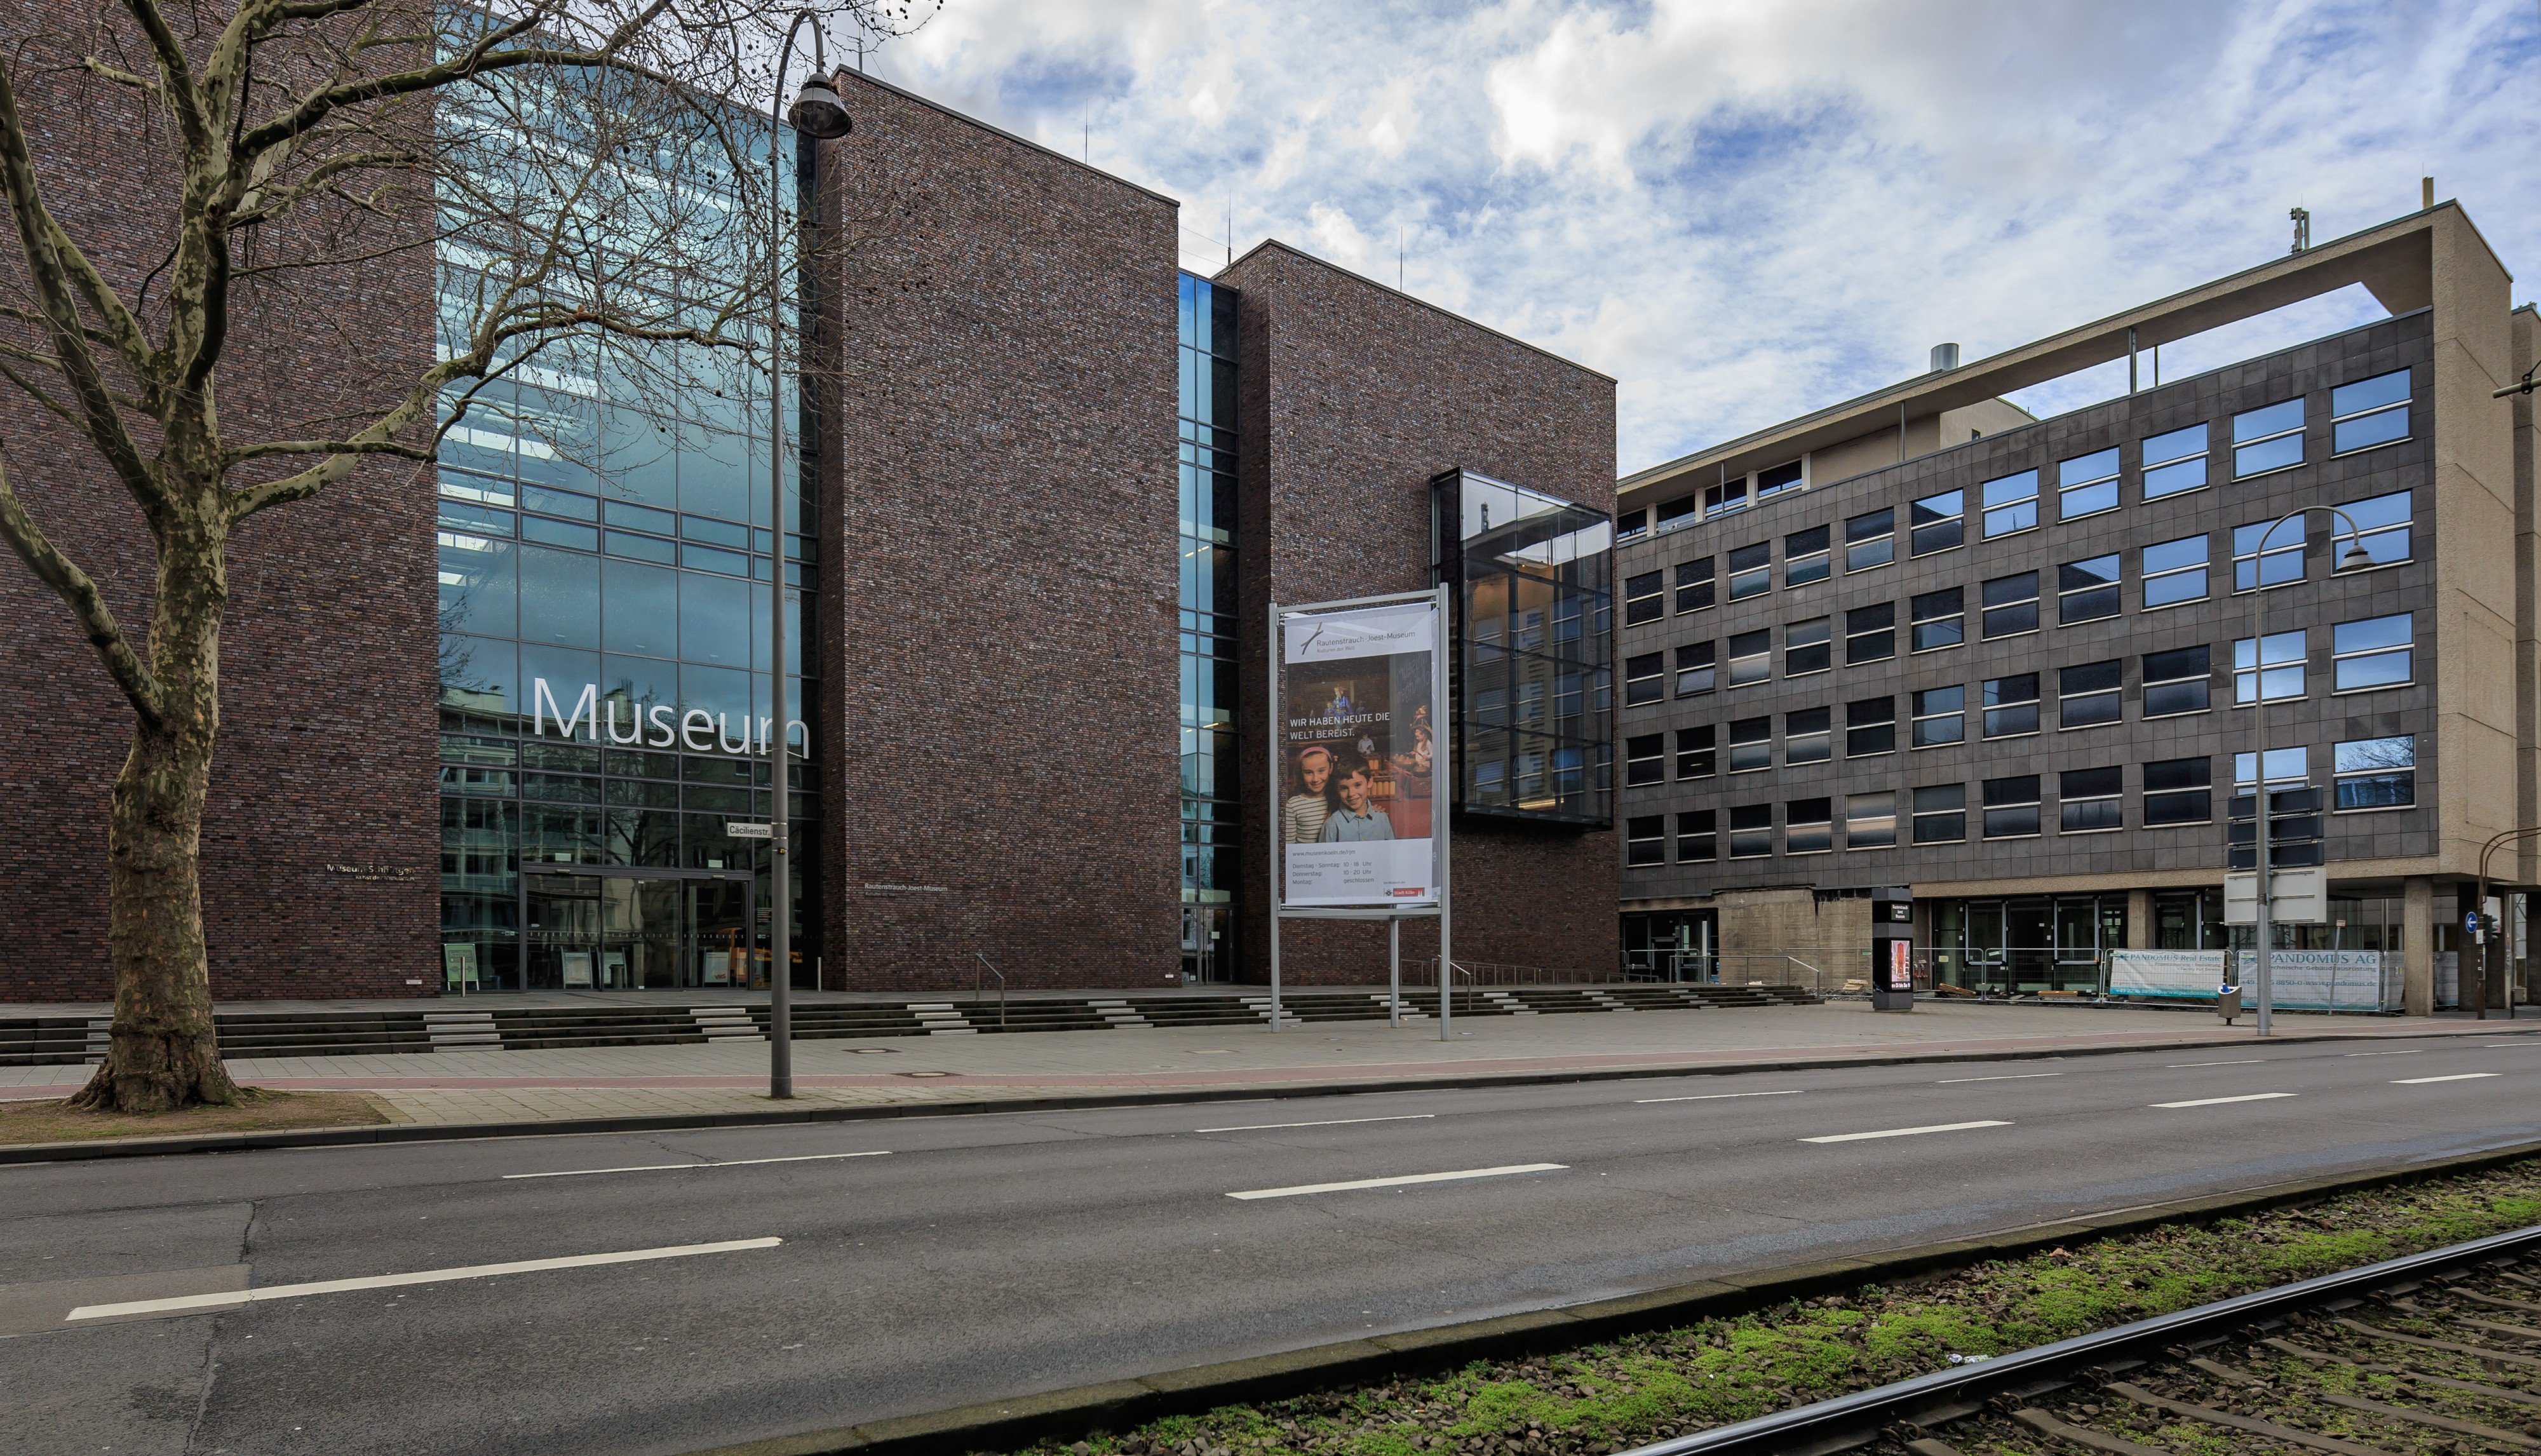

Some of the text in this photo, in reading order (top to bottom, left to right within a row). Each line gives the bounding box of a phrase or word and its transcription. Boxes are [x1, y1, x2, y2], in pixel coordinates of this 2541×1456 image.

[1317, 631, 1415, 646] Rautenstrauch-Joest-Museum
[535, 678, 809, 759] Museum
[1290, 712, 1390, 727] WIR HABEN HEUTE DIE
[1290, 728, 1355, 740] WELT BEREIST.
[729, 825, 770, 835] Cäcilienstr.
[865, 882, 948, 892] Rautenstrauch-Joest-Museum
[2355, 955, 2376, 964] AG
